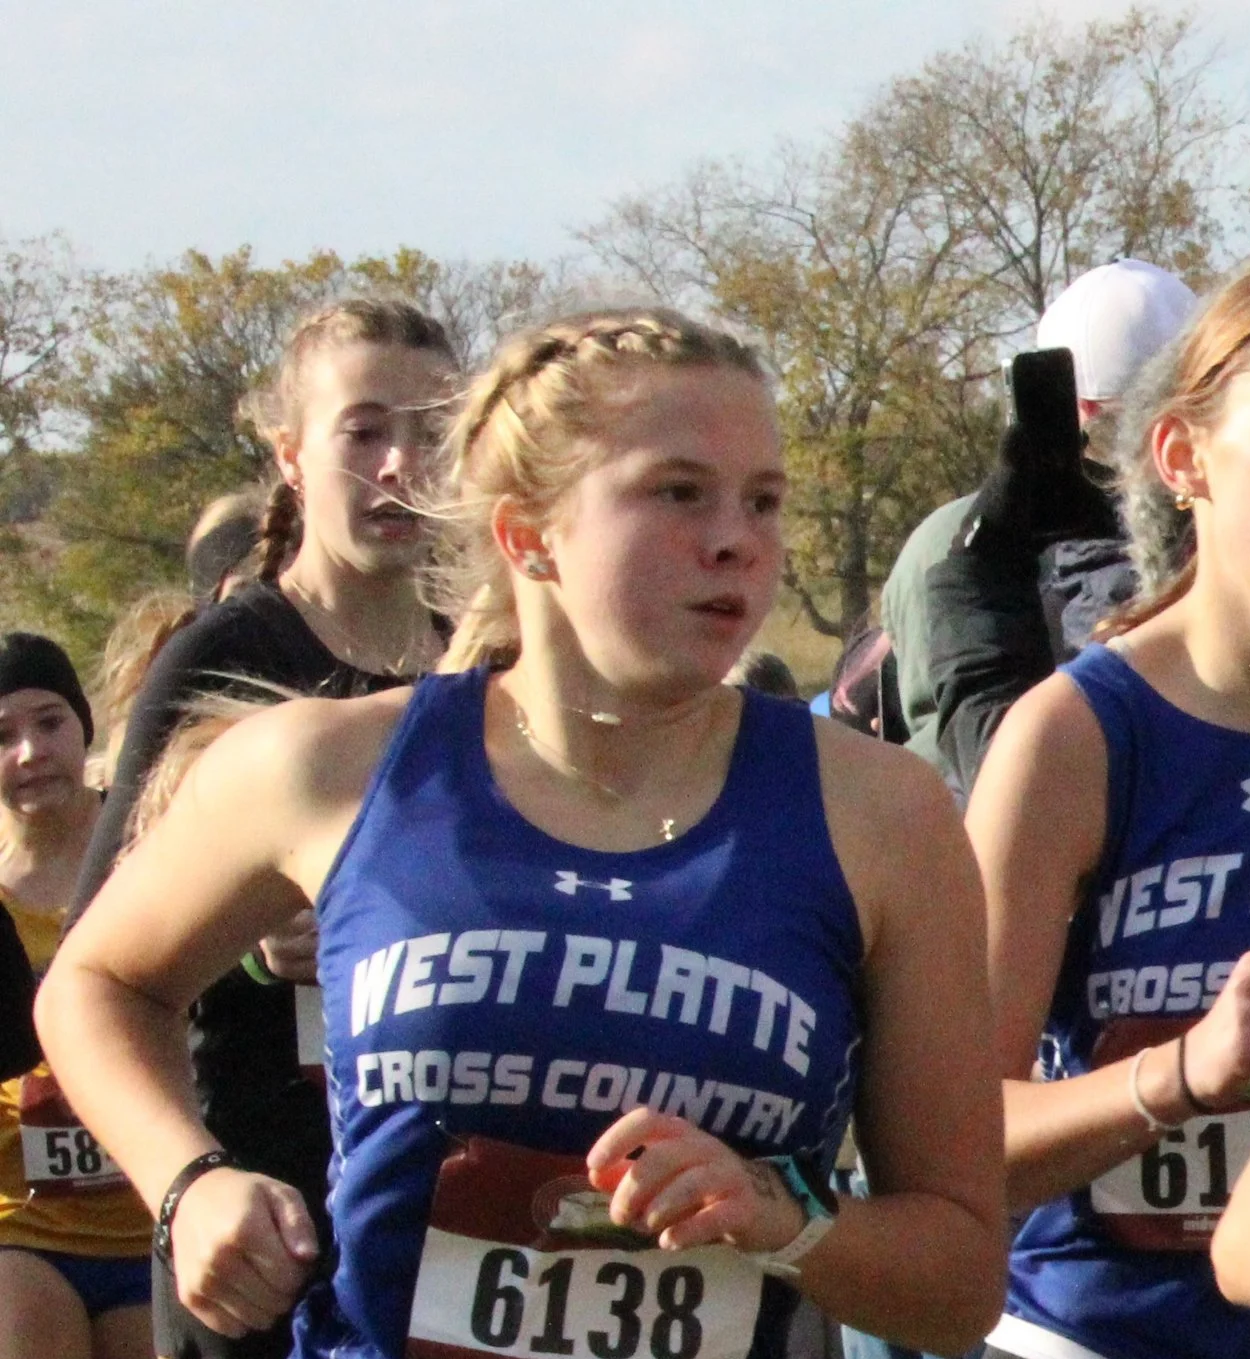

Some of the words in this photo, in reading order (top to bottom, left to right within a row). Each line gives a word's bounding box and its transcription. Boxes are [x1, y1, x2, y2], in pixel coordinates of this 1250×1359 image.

[352, 929, 547, 1037] WEST
[553, 934, 817, 1077] PLATTE
[357, 1050, 534, 1108] CROSS
[542, 1060, 806, 1146] COUNTRY
[45, 1129, 111, 1176] 58
